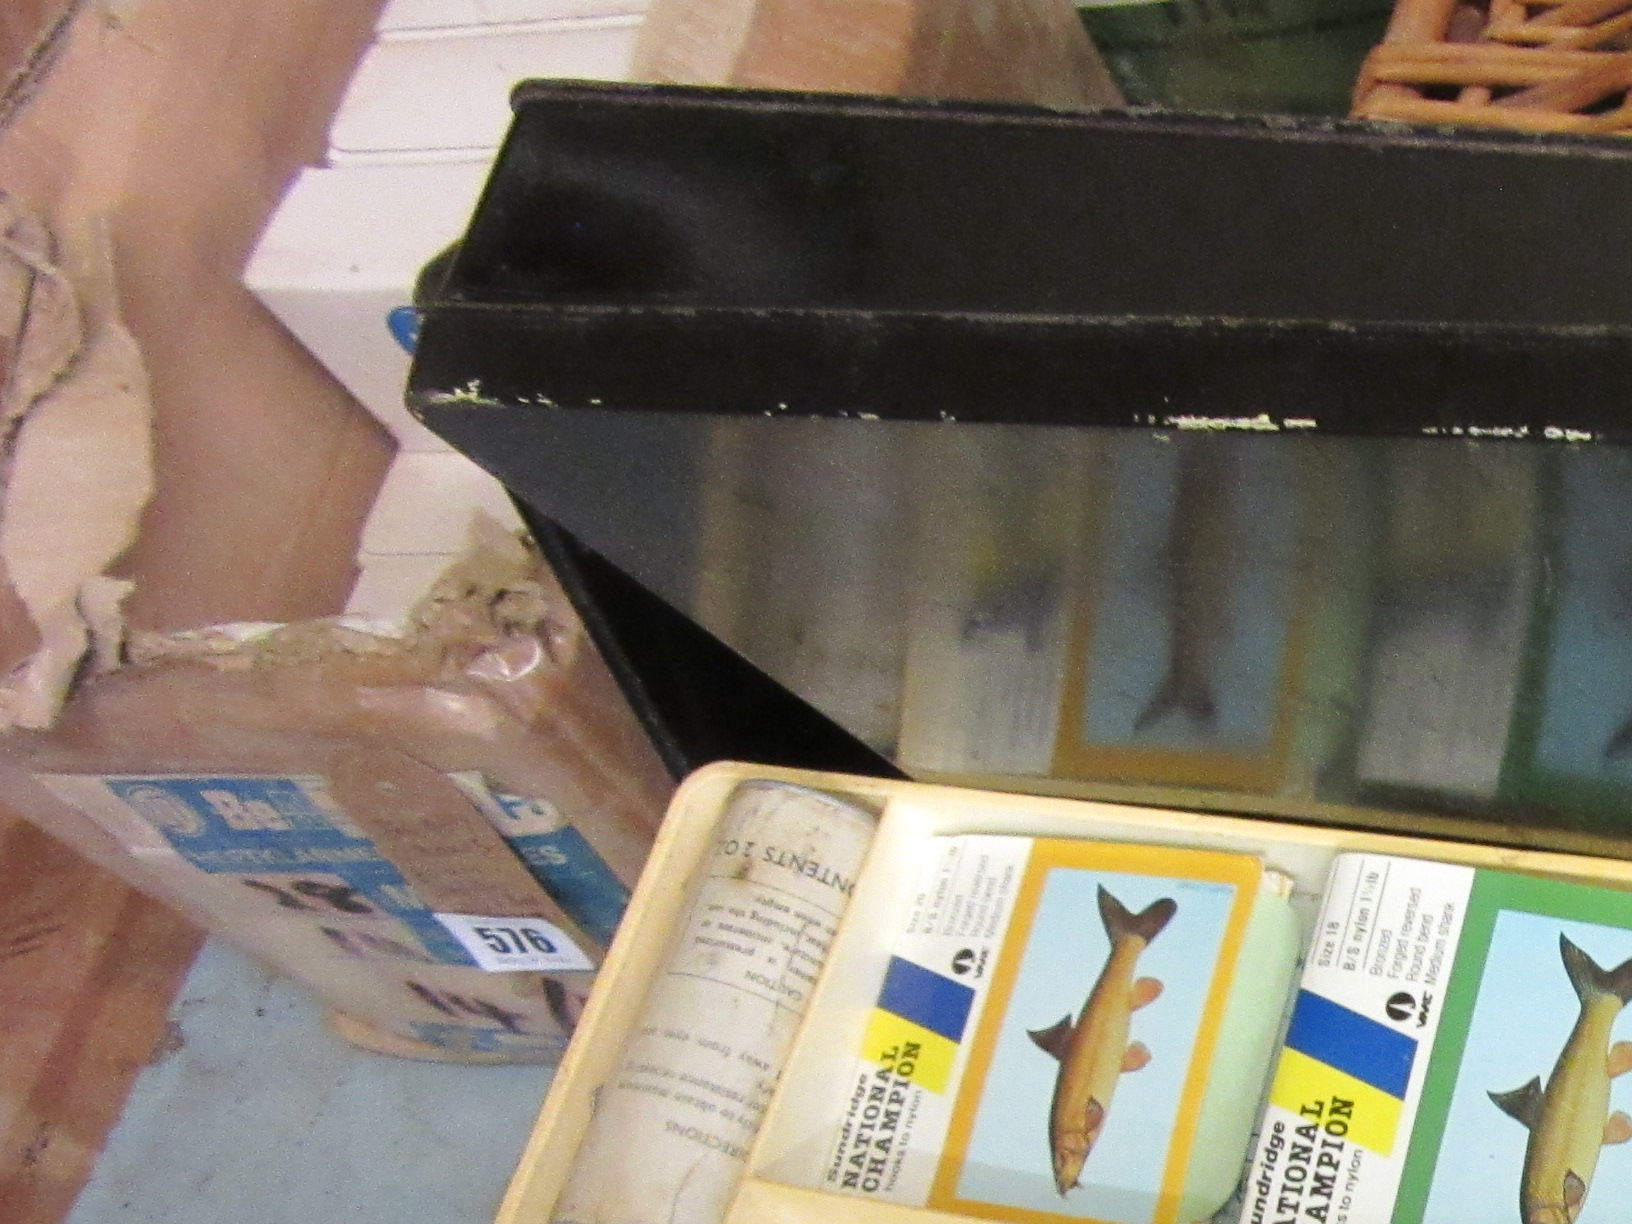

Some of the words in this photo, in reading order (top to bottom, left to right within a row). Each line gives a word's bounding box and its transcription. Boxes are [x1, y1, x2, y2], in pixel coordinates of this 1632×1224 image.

[473, 927, 558, 954] 576
[1318, 941, 1334, 965] Size
[1343, 947, 1359, 969] B/S
[1352, 908, 1368, 941] nylon
[826, 1074, 869, 1181] Sundridge
[840, 1042, 900, 1190] NATIONAL
[861, 1040, 922, 1194] CHAMPION
[1343, 1148, 1363, 1190] nylon
[1339, 1194, 1351, 1209] to
